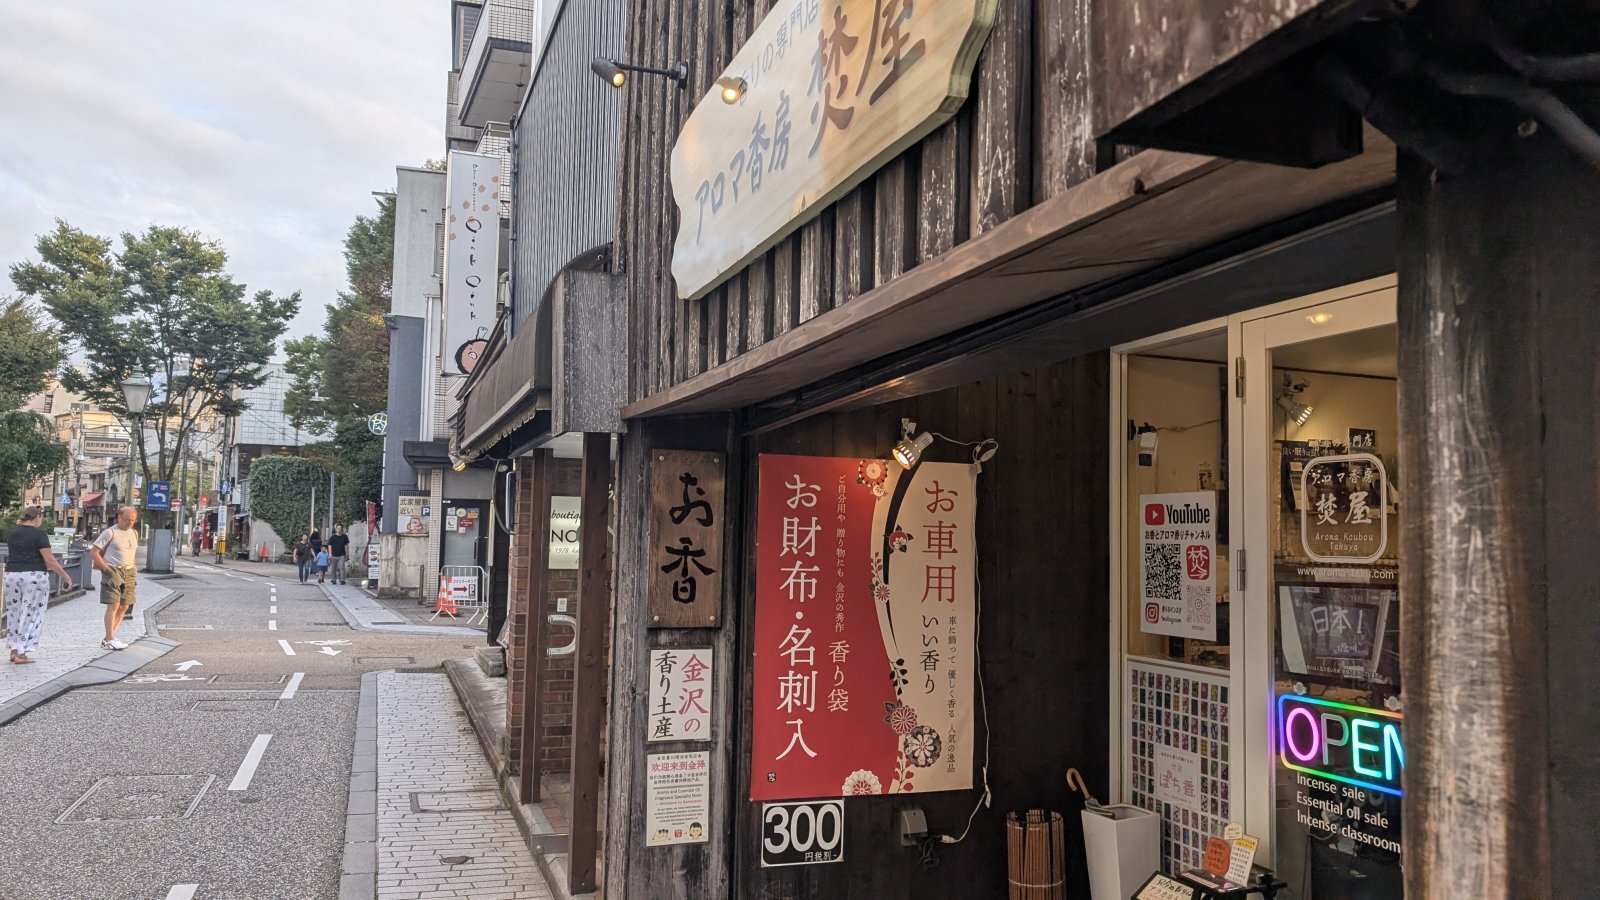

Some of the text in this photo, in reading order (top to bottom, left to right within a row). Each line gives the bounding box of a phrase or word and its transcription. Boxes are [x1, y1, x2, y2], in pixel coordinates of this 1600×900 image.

[694, 89, 792, 245] アロマ香房
[1166, 502, 1210, 525] YouTube
[1311, 469, 1374, 486] アロマ香房
[1314, 490, 1373, 526] 焚屋
[661, 472, 717, 604] お香
[834, 475, 847, 633] ご自分用や 贈り物にも 金沢の秀作
[921, 479, 959, 604] お車用
[1315, 532, 1374, 542] Aroma Koubou
[1330, 541, 1358, 552] Takuya
[775, 473, 822, 761] お財布・名刺入
[828, 640, 850, 713] 香り袋
[919, 614, 941, 695] いい香り
[652, 650, 678, 739] 香り土産
[679, 653, 710, 733] 金沢の
[1285, 707, 1405, 781] OPEN
[1296, 791, 1389, 829] Essential oil sale
[1297, 771, 1365, 802] Incense sale
[764, 804, 842, 854] 300
[1297, 810, 1401, 854] Incense classroom
